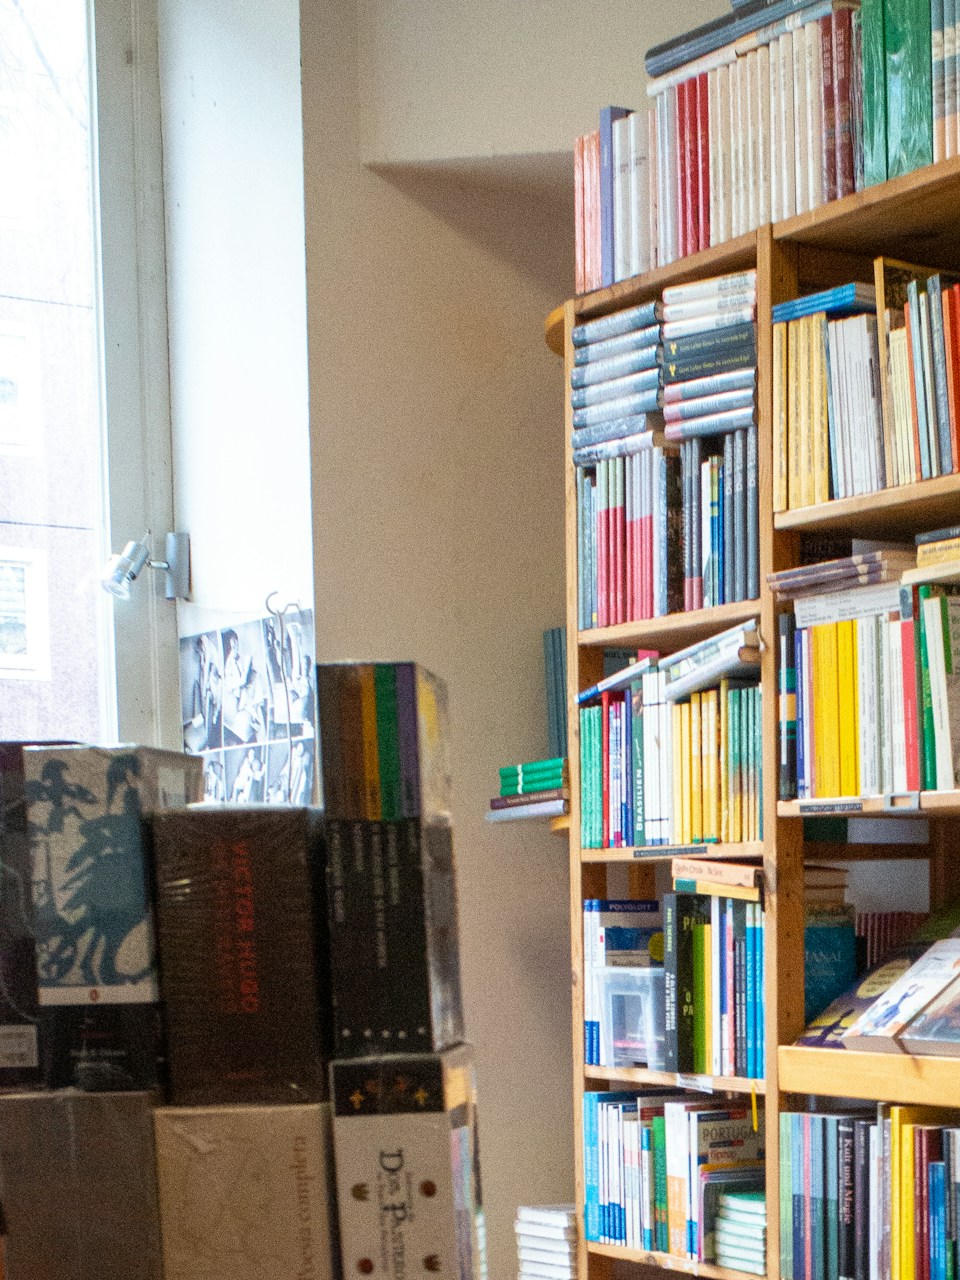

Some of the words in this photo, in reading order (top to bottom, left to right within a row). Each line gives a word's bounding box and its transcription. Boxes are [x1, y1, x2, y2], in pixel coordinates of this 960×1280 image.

[841, 1138, 853, 1165] Kult
[842, 1168, 853, 1185] und
[841, 1189, 854, 1225] Magie
